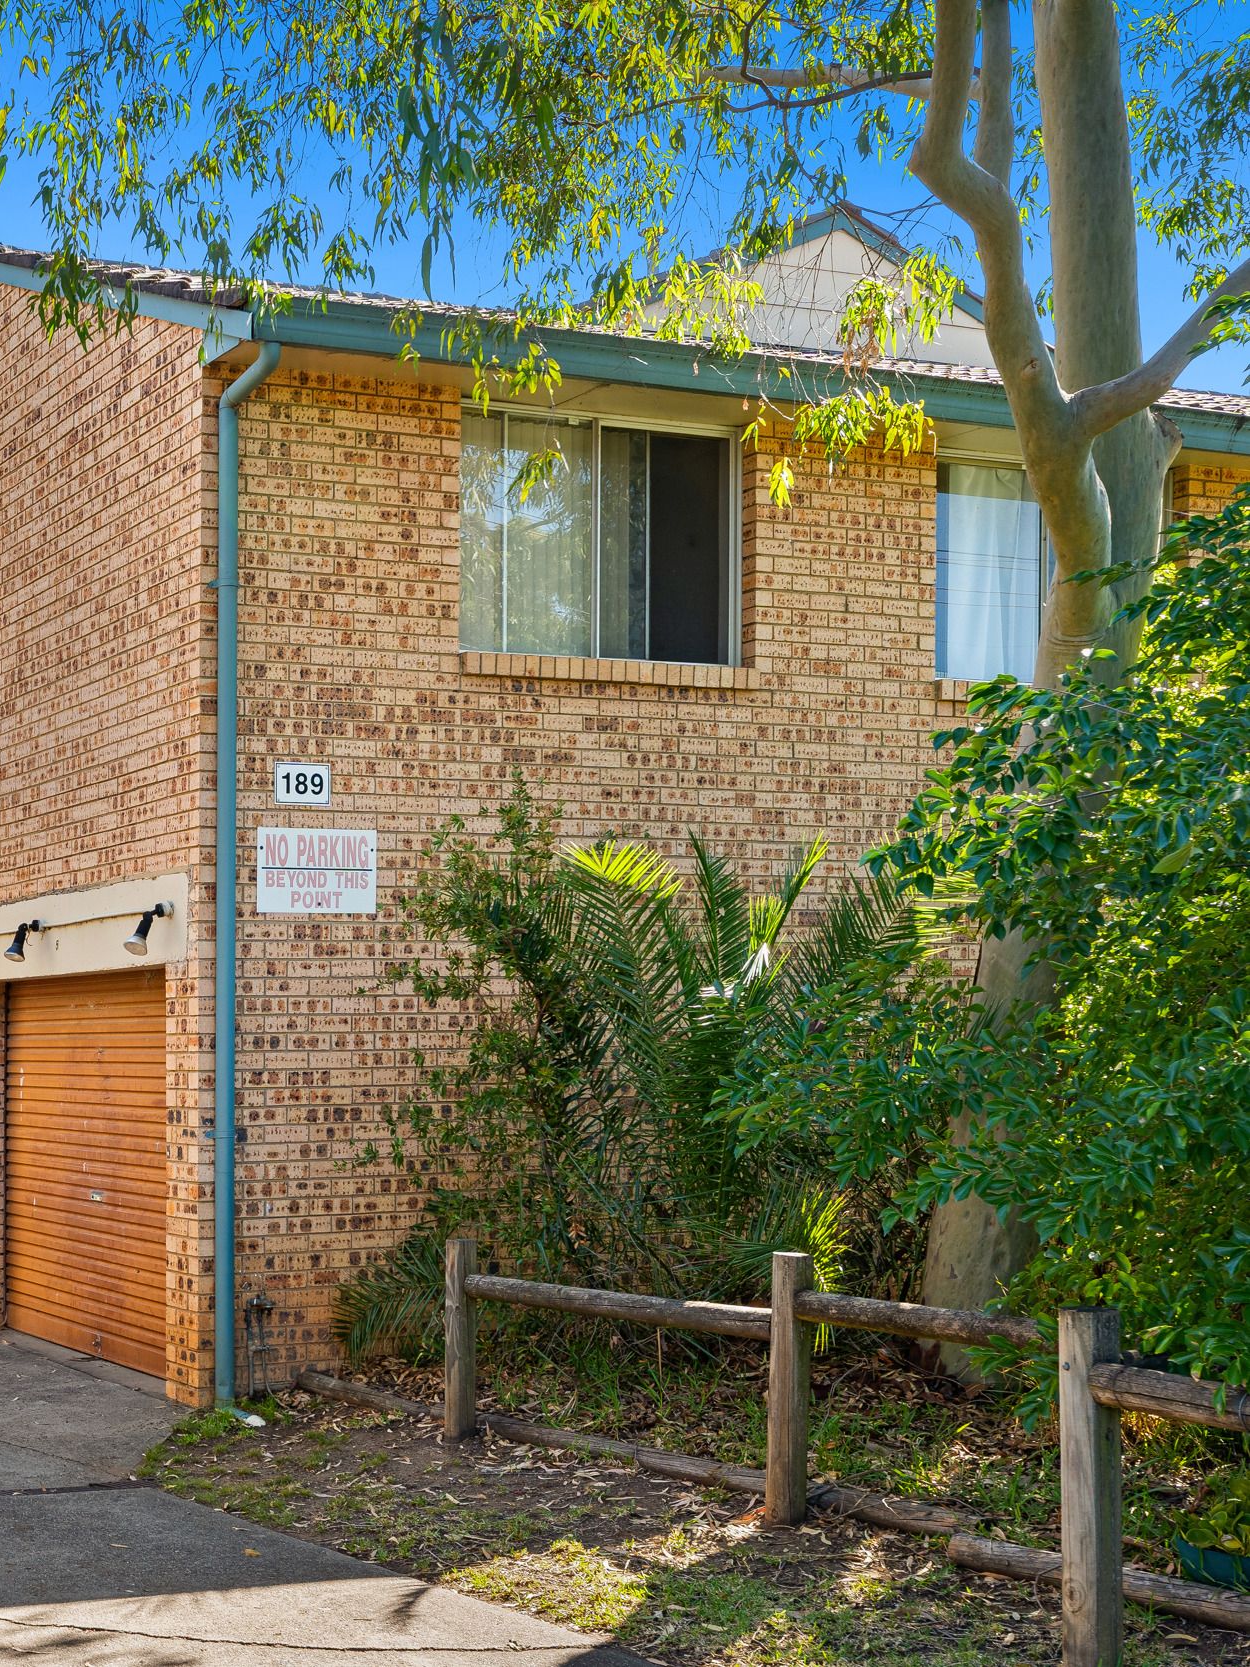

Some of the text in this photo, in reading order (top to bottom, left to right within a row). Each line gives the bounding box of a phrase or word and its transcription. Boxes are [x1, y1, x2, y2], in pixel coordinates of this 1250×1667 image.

[281, 772, 324, 795] 189
[265, 833, 369, 869] NO PARKING
[265, 870, 369, 890] BEYOND THIS
[290, 890, 343, 909] POINT
